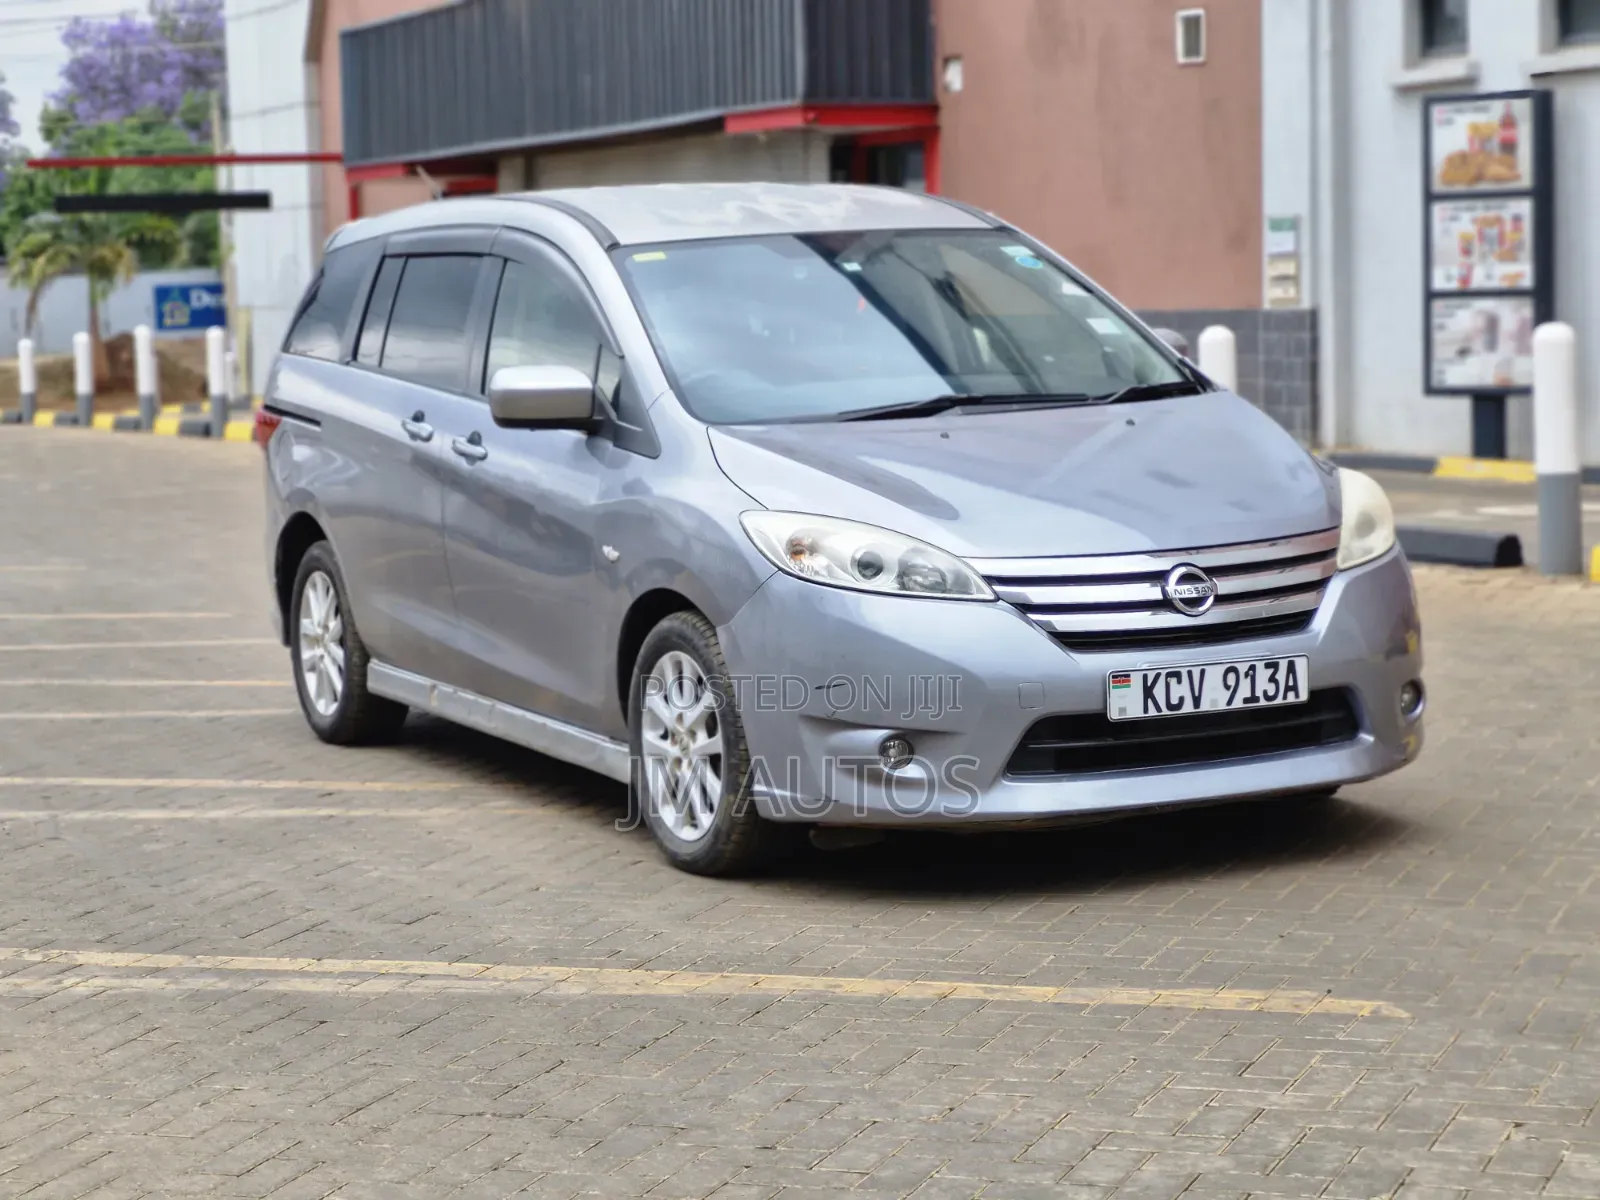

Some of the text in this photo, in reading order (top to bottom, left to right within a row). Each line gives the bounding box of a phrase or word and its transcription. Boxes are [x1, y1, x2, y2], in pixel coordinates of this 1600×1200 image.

[1173, 585, 1214, 597] NISSAN
[1141, 659, 1300, 715] KCV 913A
